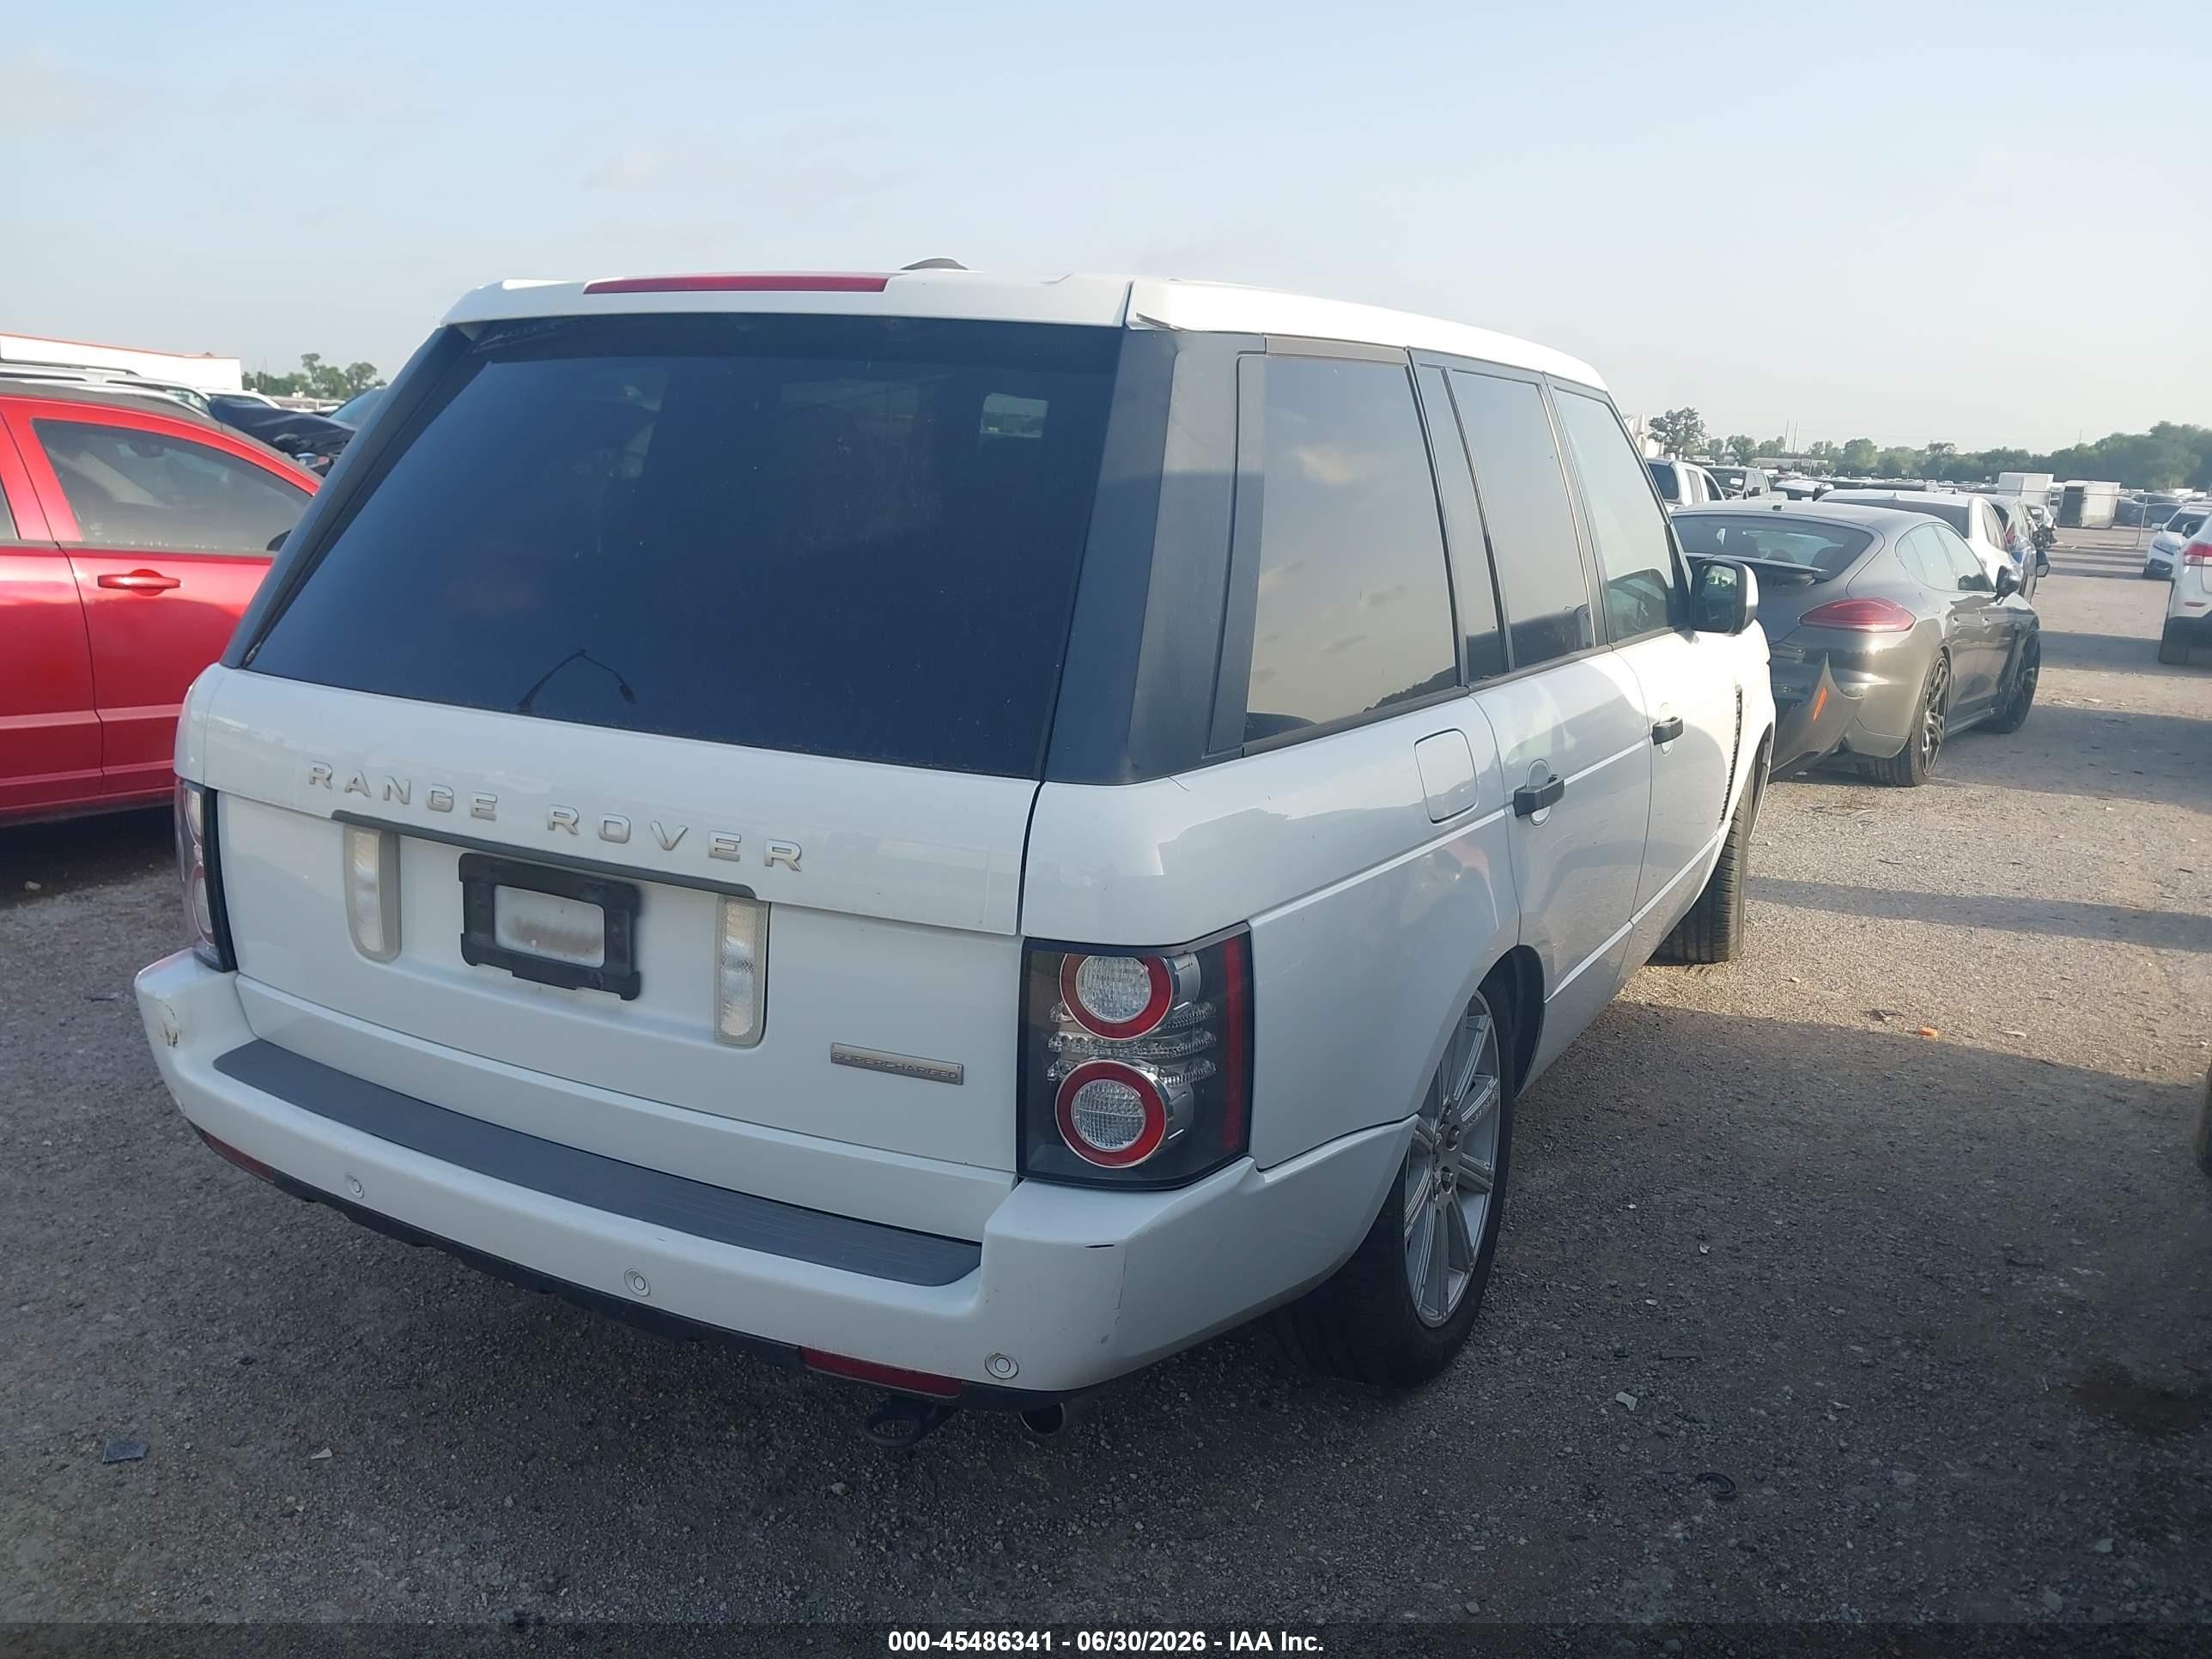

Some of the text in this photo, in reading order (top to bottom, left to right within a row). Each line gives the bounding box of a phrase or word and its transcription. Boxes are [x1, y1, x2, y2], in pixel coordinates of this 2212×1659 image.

[309, 760, 803, 873] RANGE ROVER
[832, 1050, 959, 1079] SUPERCHARGED
